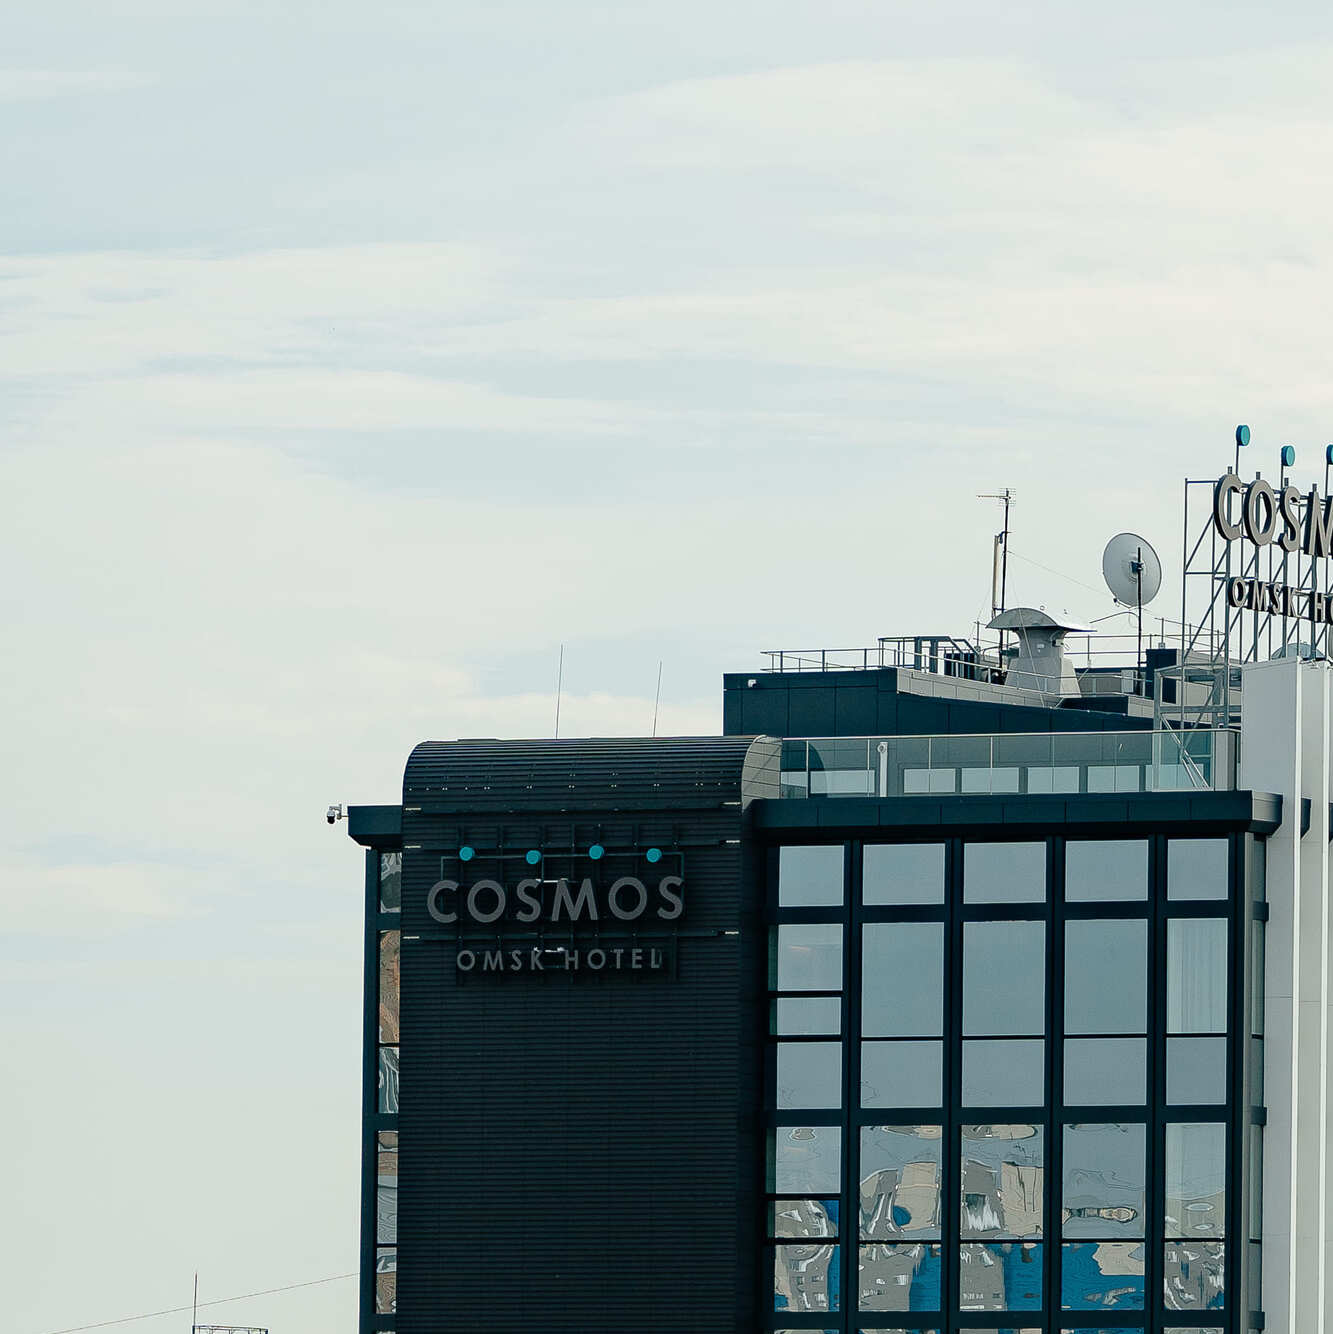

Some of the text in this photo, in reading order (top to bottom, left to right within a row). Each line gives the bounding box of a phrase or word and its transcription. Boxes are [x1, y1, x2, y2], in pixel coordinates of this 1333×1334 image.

[1228, 576, 1300, 618] OMSK
[427, 876, 684, 923] COSMOS
[457, 948, 663, 971] OMSK HOTEL
